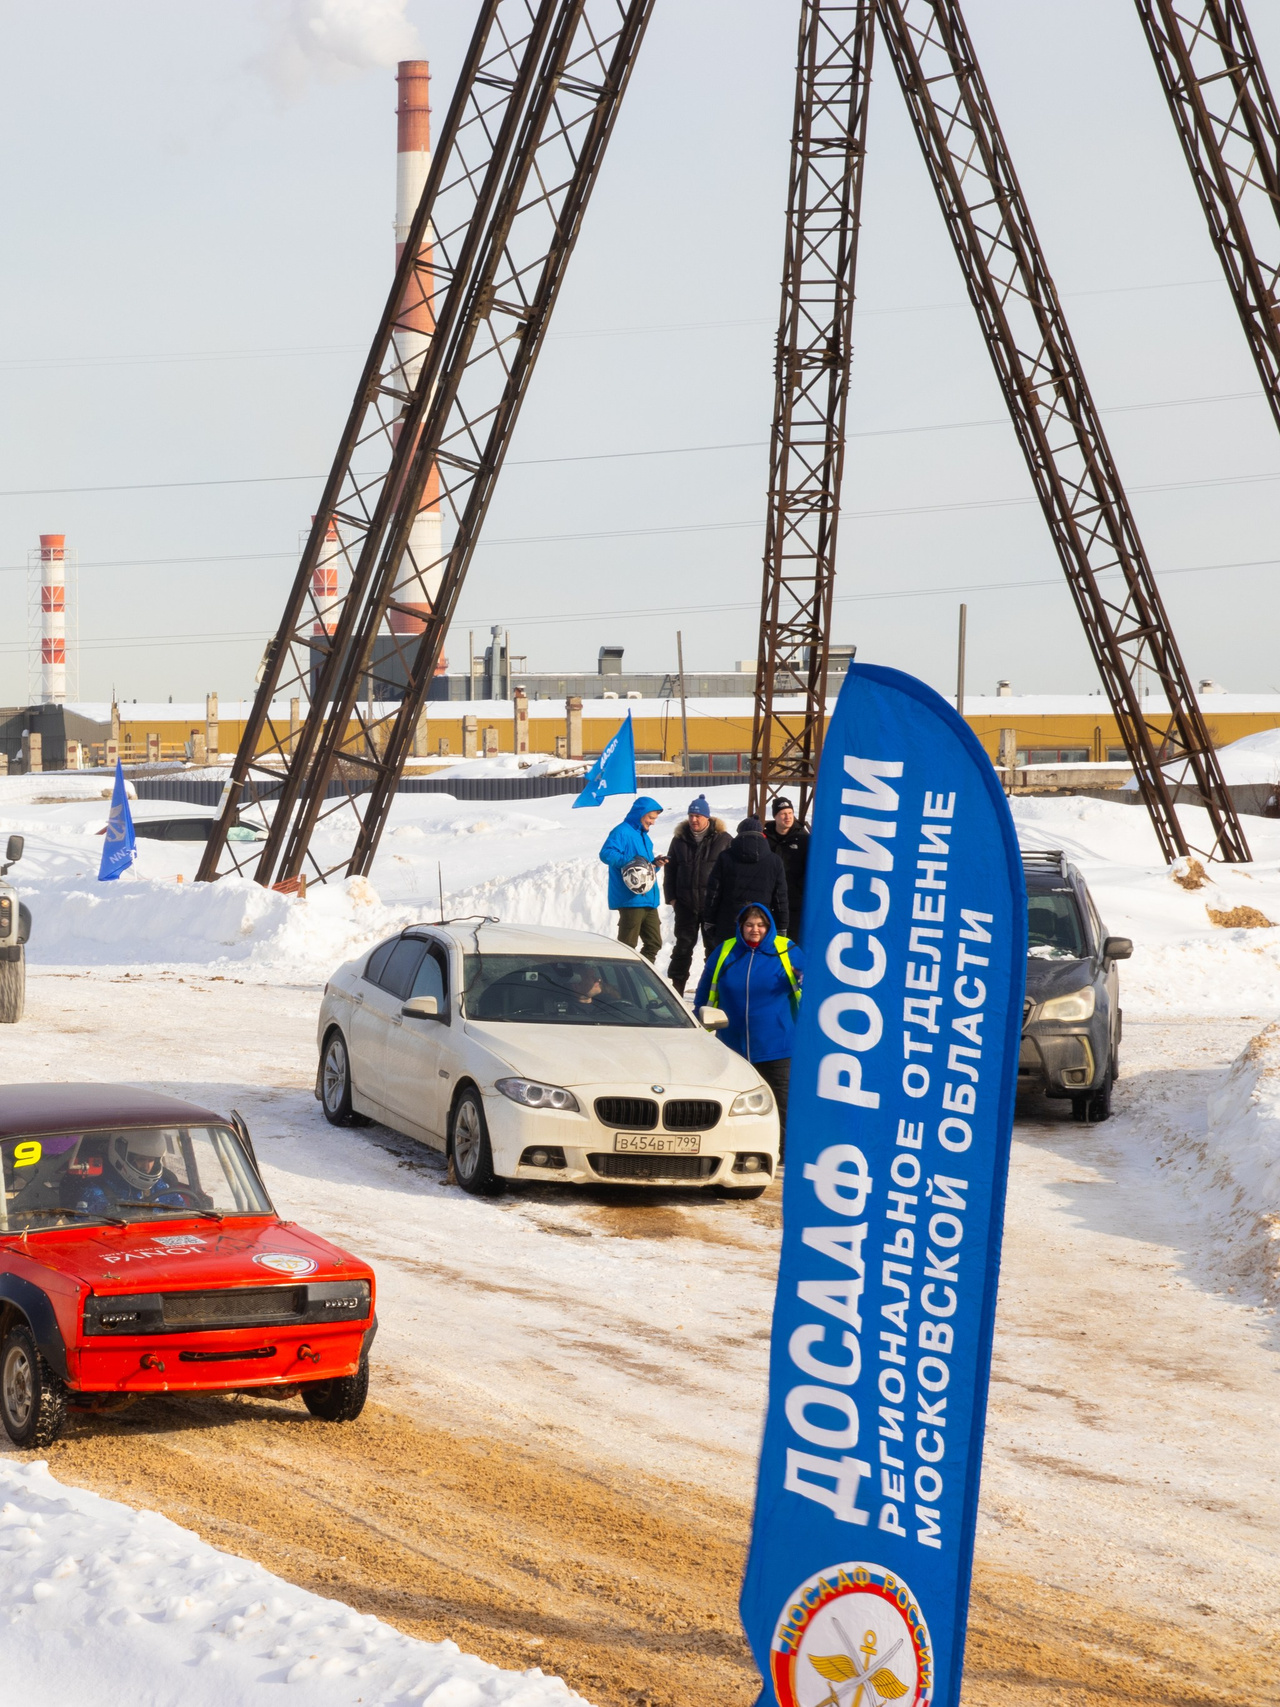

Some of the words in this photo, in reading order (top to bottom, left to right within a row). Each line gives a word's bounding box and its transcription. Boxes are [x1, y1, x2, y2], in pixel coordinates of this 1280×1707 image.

[816, 755, 904, 1109] РОССИИ
[938, 908, 994, 1153] ОБЛАСТИ
[13, 1140, 42, 1168] 9
[620, 1136, 674, 1151] В454ВТ
[677, 1136, 697, 1147] 799
[878, 1119, 924, 1538] РЕГИОНАЛЬНОЕ
[902, 791, 956, 1098] ОТДЕЛЕНИЕ
[783, 1144, 873, 1526] ДОСААФ
[914, 1173, 969, 1550] МОСКОВСКОЙ
[778, 1566, 871, 1650] ДОСААФ
[882, 1574, 932, 1689] РОССИИ
